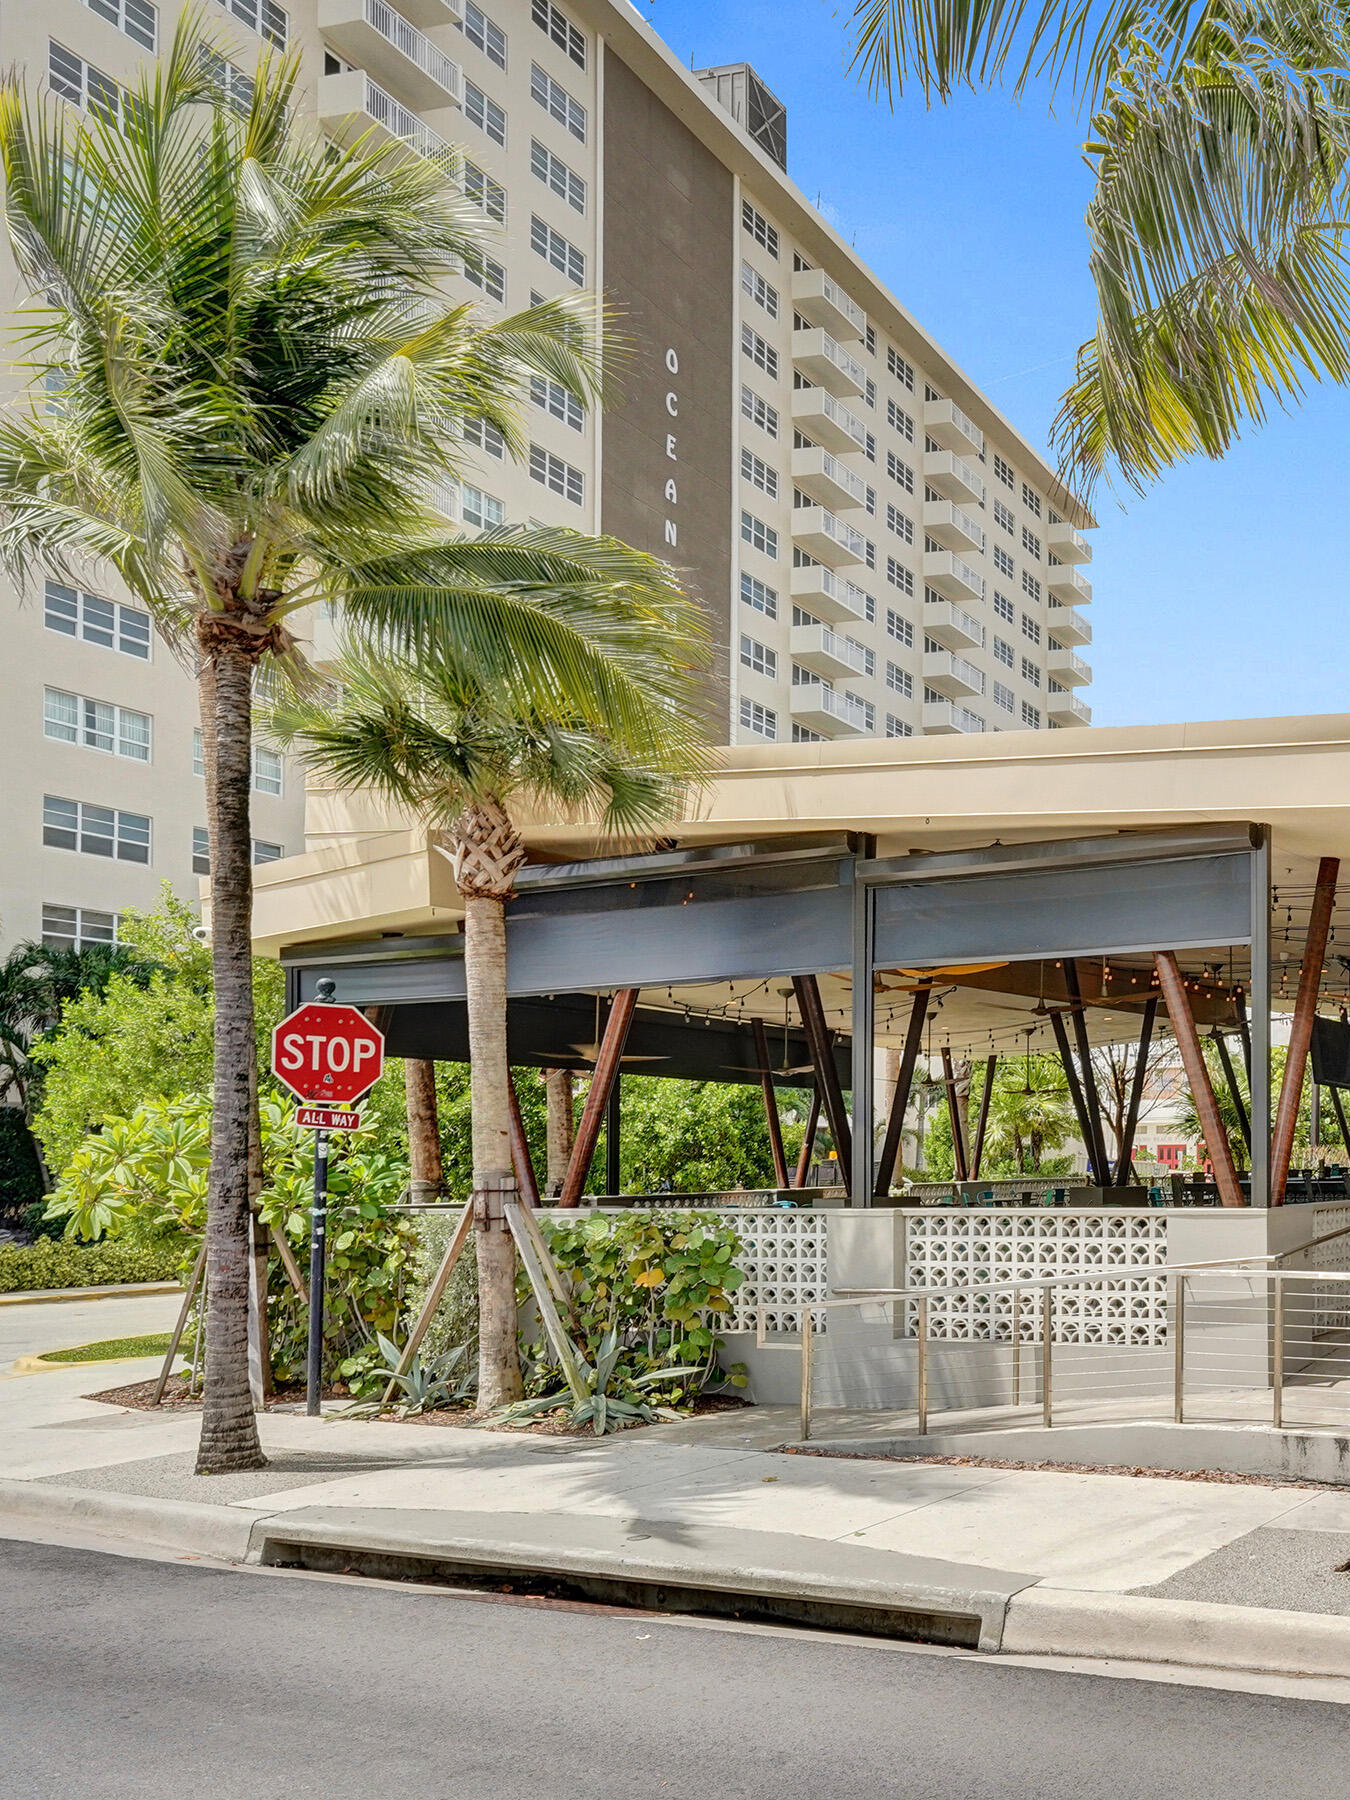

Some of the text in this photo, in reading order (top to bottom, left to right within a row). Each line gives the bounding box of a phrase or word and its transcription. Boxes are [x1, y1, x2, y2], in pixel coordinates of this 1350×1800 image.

[664, 348, 680, 548] OCEAN
[281, 1033, 376, 1073] STOP
[302, 1111, 355, 1127] ALL WAY
